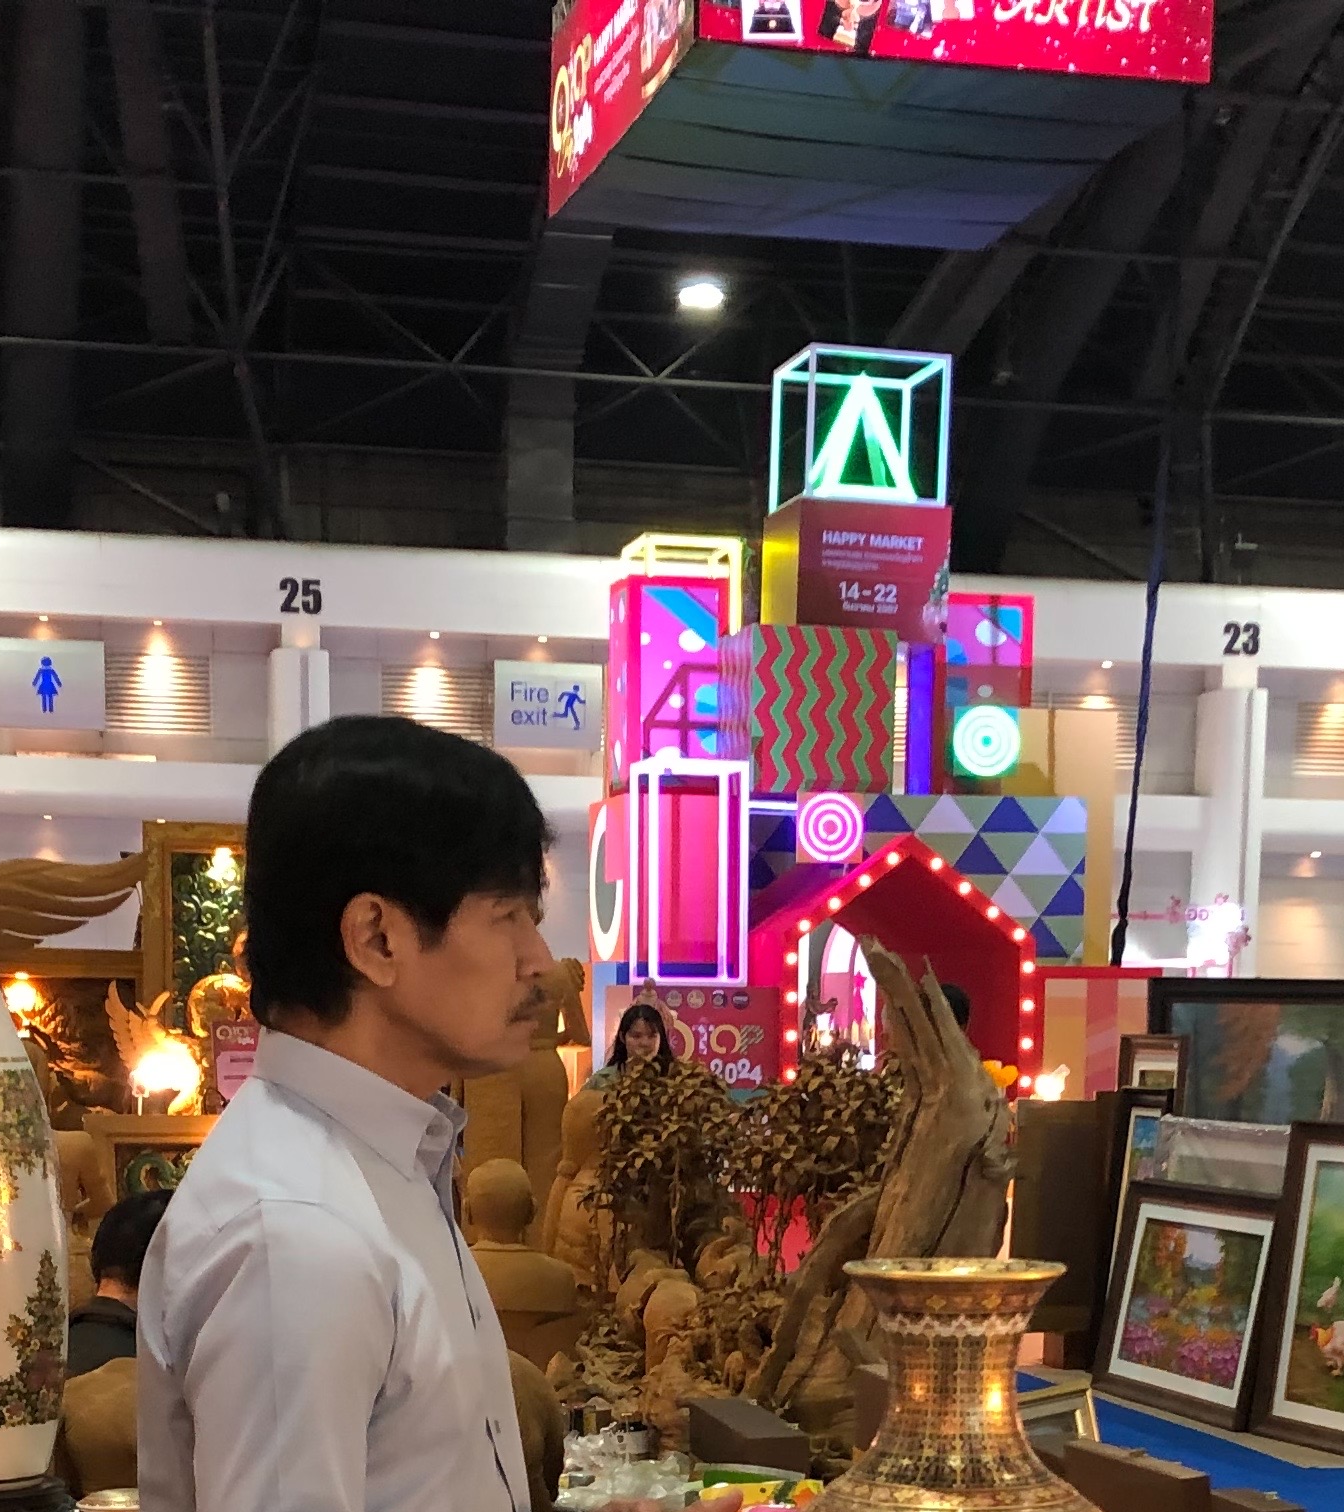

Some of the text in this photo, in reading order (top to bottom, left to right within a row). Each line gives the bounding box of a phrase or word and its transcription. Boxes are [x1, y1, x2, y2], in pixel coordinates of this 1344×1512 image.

[822, 530, 924, 551] HAPPY MARKET
[280, 578, 322, 615] 25
[1223, 623, 1260, 657] 23
[511, 681, 549, 704] Fire
[511, 708, 547, 726] exit
[710, 1057, 763, 1086] 2024
